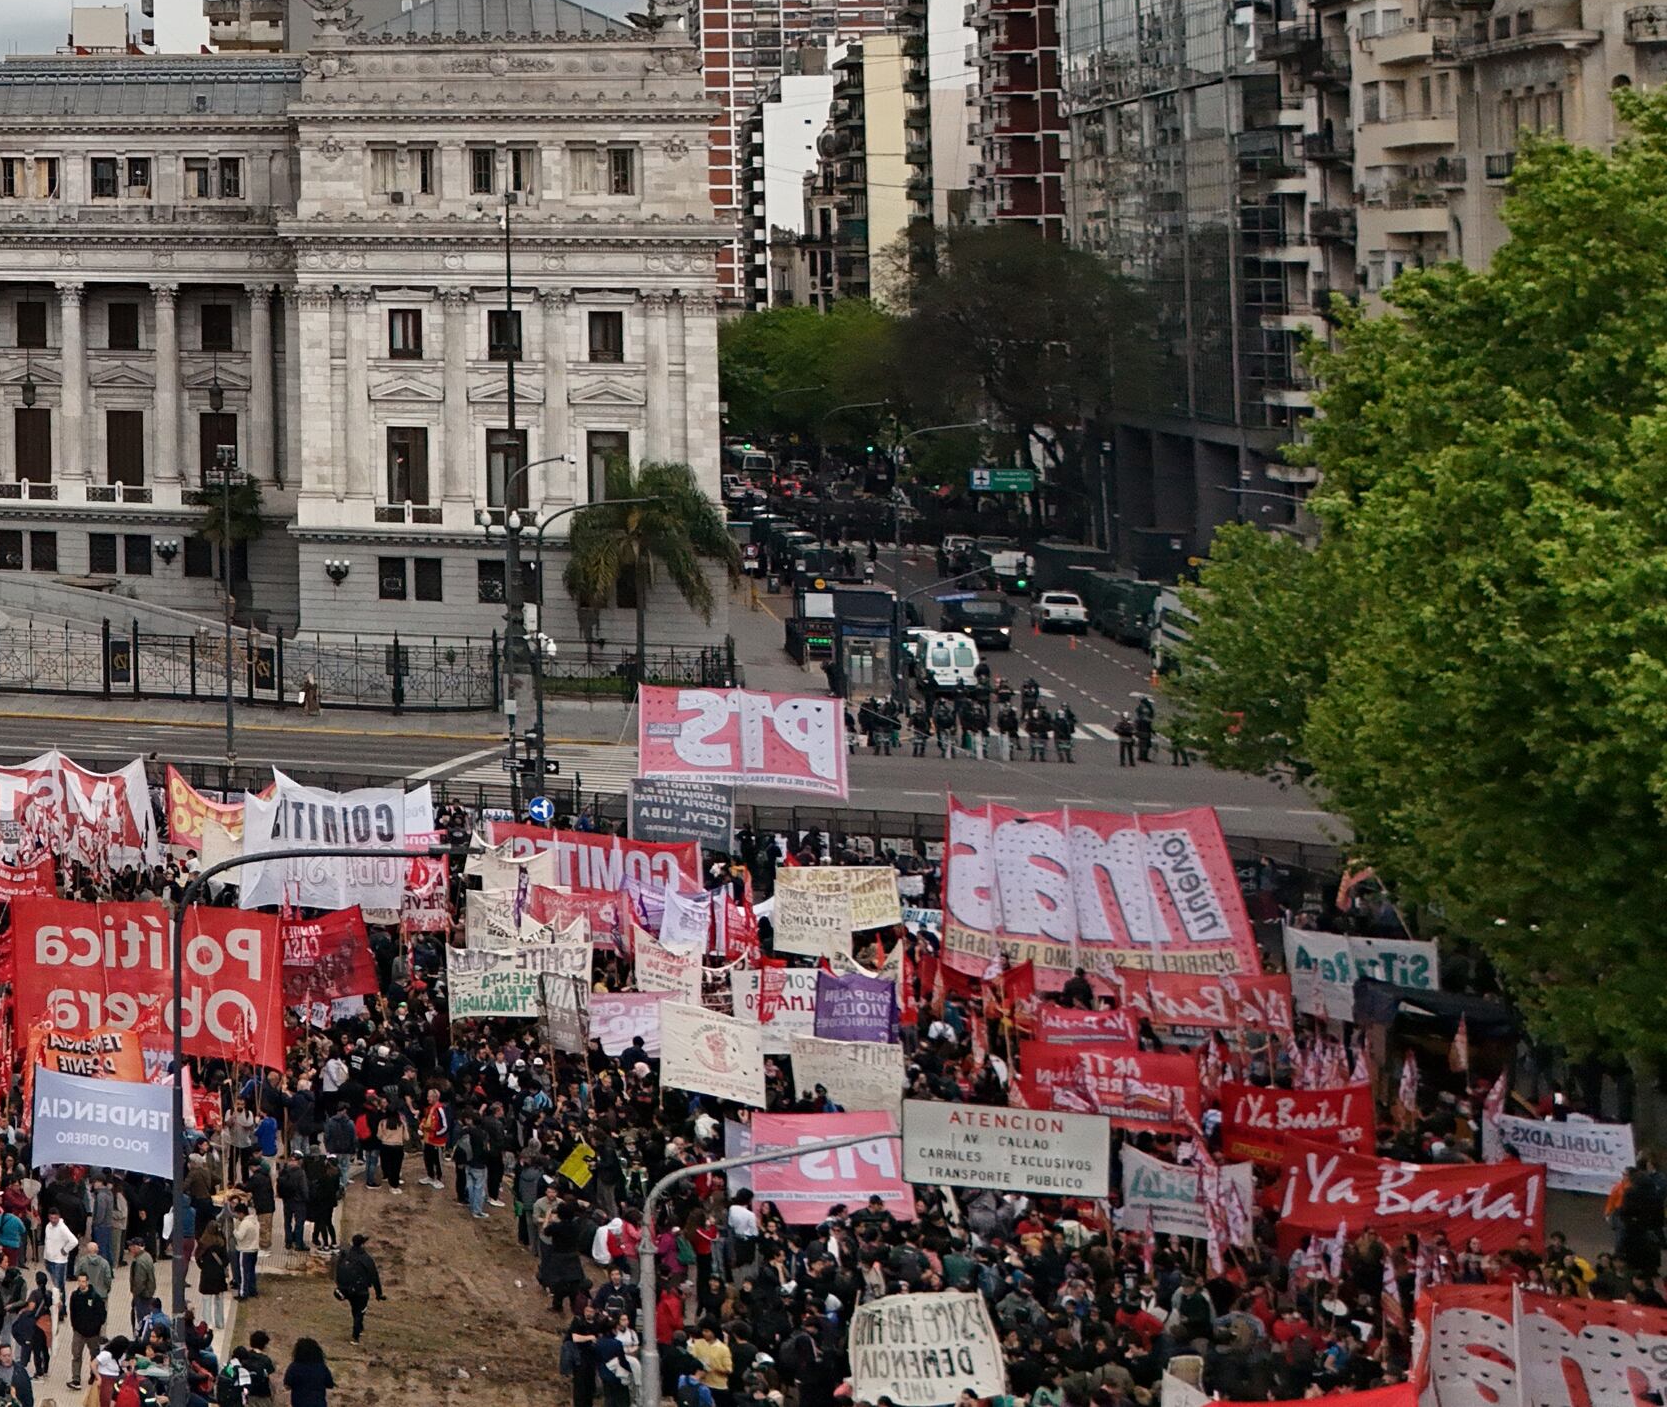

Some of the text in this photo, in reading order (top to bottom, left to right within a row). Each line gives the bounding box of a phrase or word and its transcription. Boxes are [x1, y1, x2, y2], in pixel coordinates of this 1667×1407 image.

[949, 1110, 1064, 1134] ATENCION
[1233, 1093, 1354, 1130] ¡Ya Basta!
[997, 1136, 1050, 1151] CALLAO
[919, 1147, 1093, 1172] CARRILES EXCLUSIVOS
[928, 1166, 1084, 1189] TRANSPORTE PUBLICO
[1280, 1152, 1541, 1227] ¡Ya Basta!
